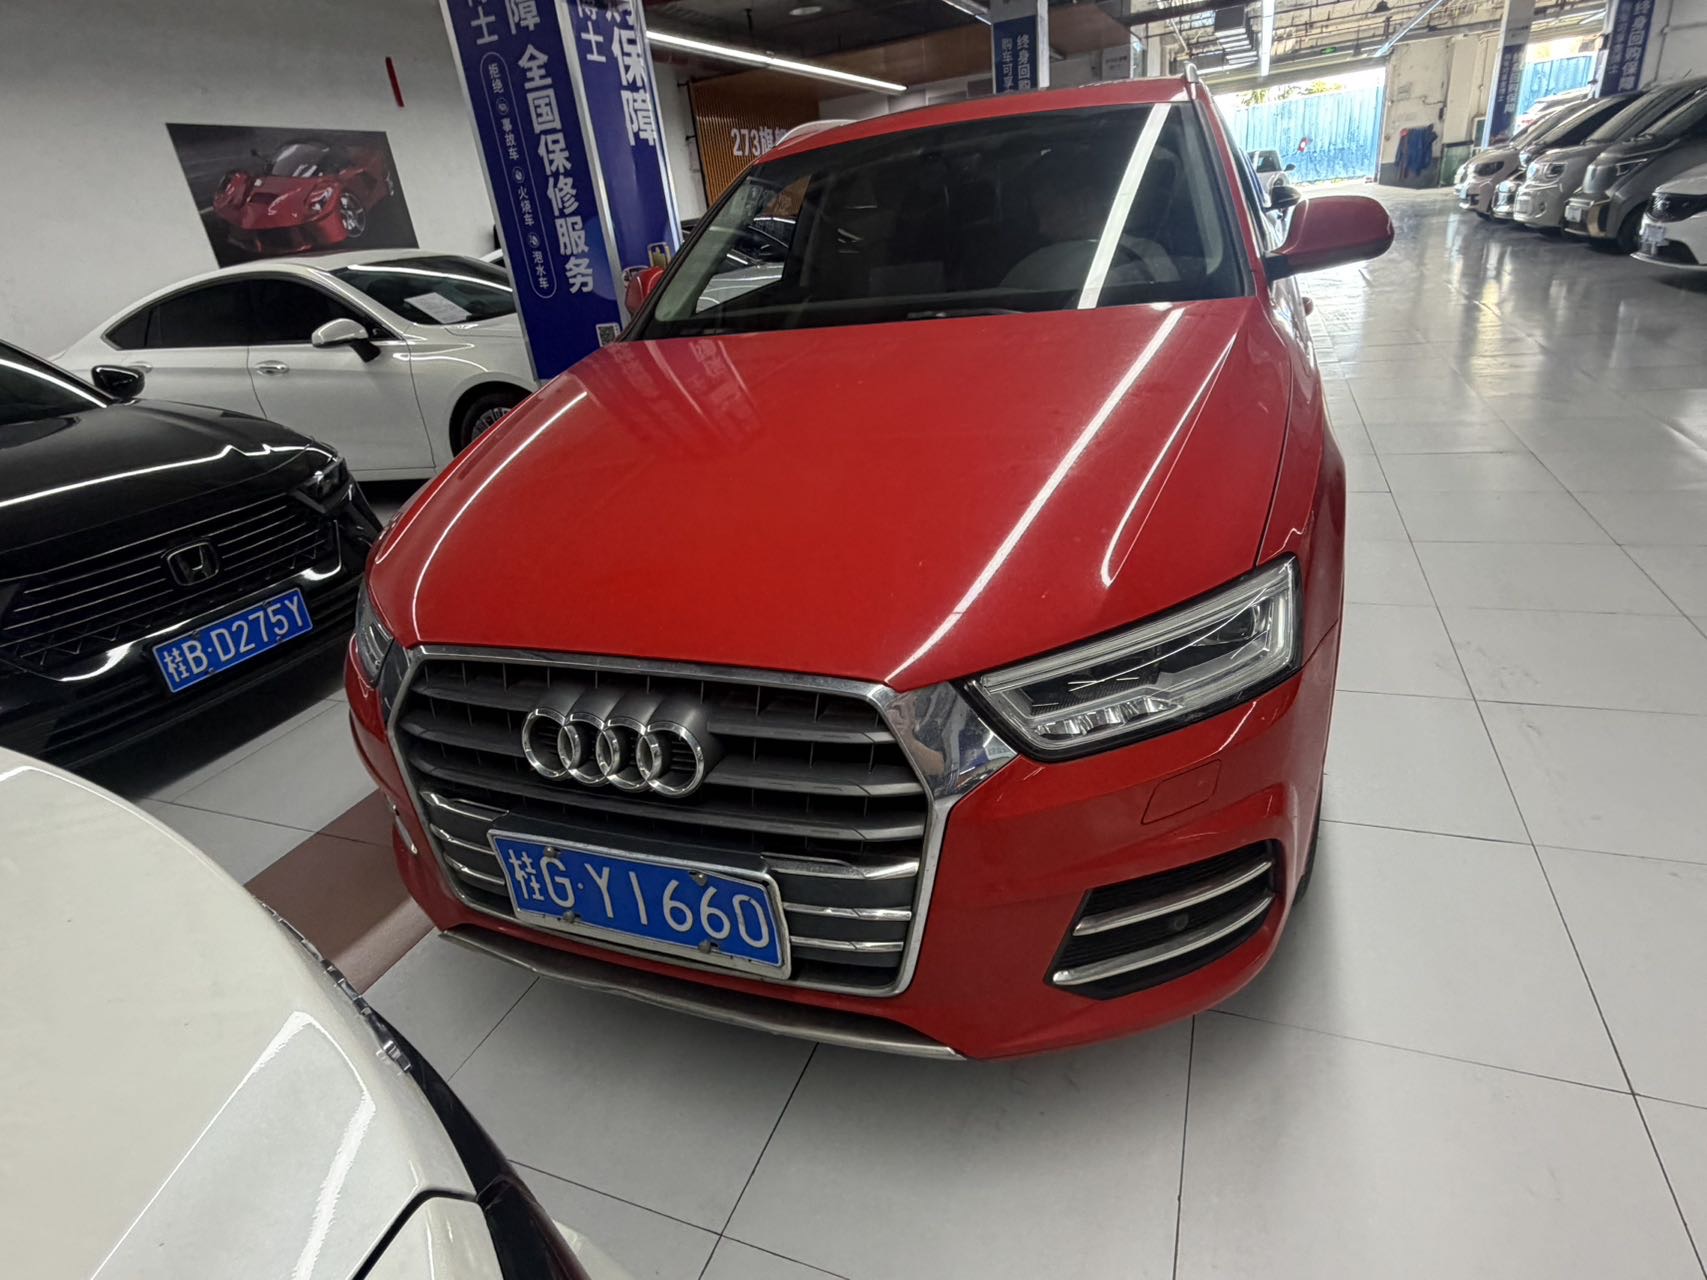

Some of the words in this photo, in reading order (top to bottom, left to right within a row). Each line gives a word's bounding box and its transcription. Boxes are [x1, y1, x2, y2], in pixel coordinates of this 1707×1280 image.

[501, 118, 519, 160] 事故车
[518, 186, 534, 226] 火烧车
